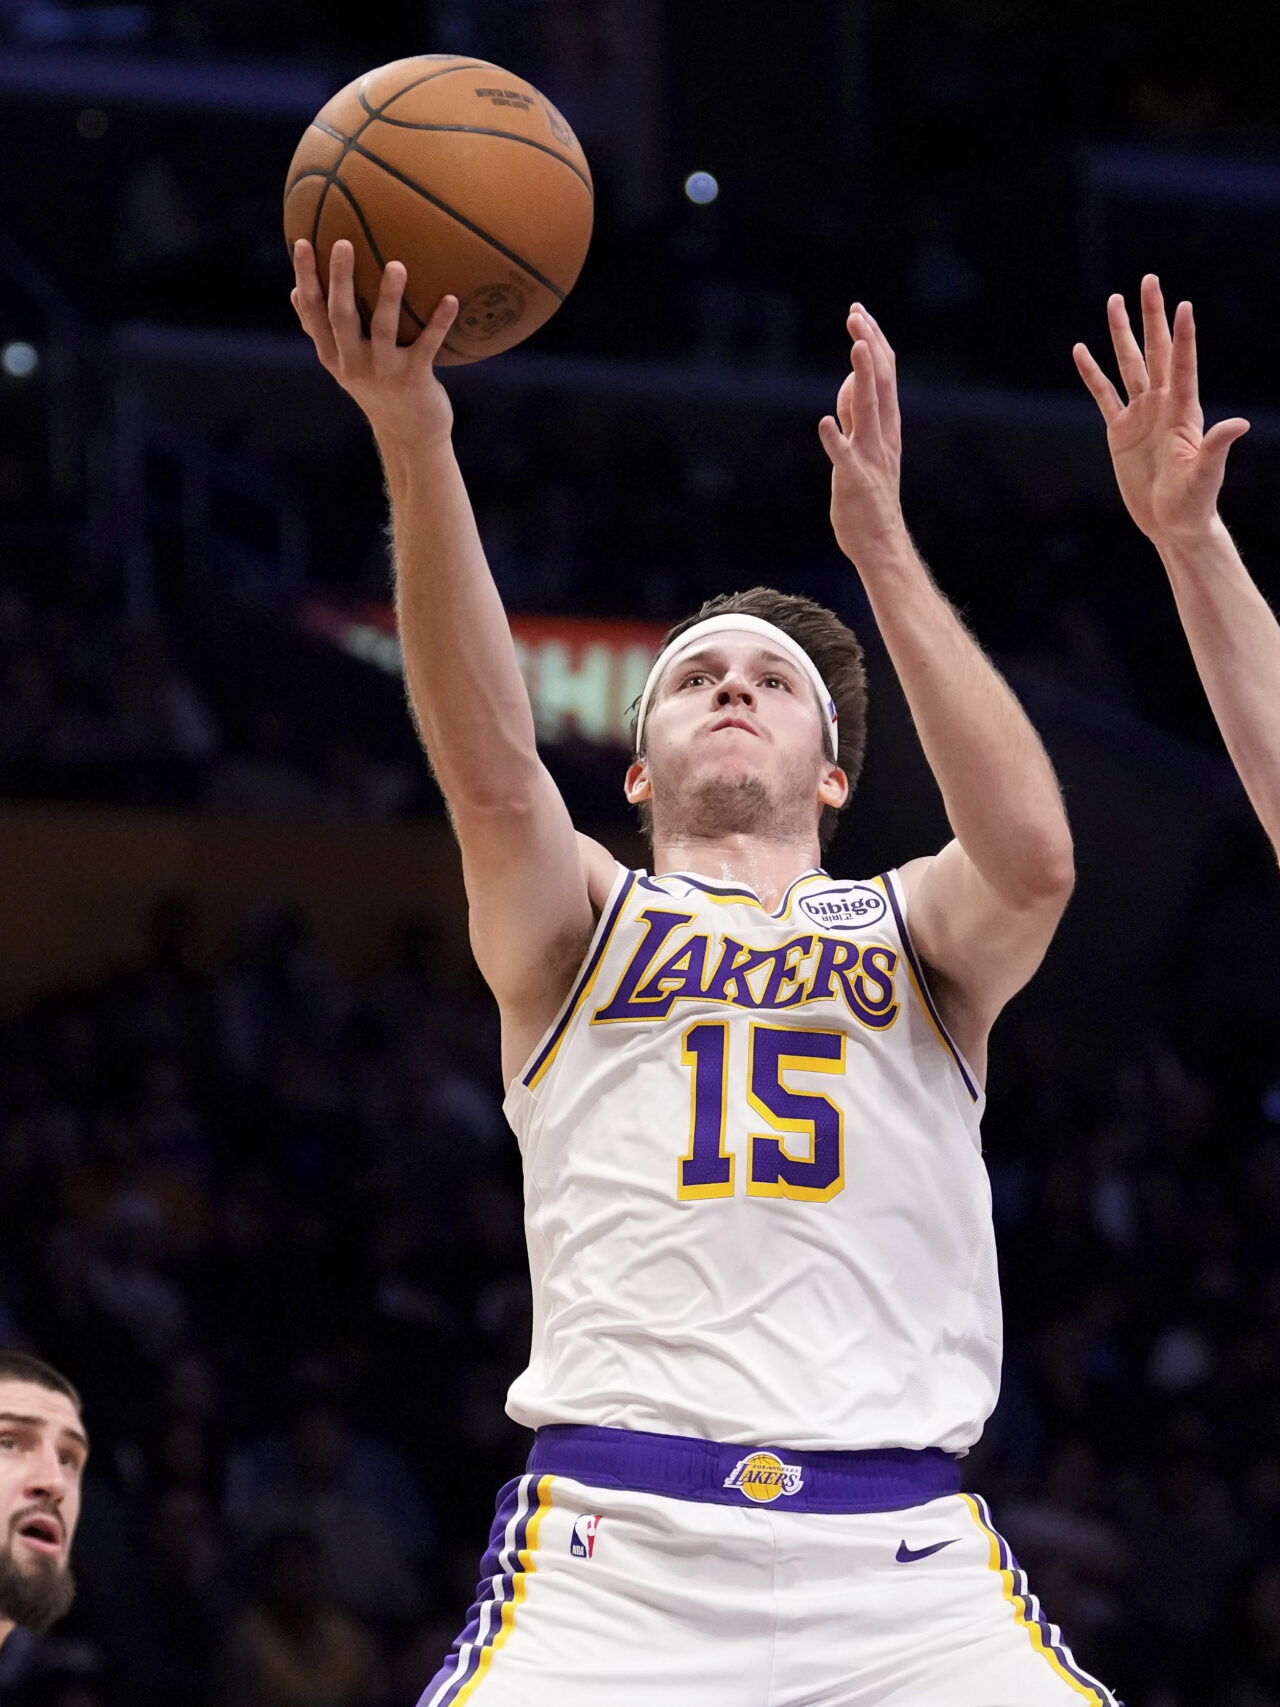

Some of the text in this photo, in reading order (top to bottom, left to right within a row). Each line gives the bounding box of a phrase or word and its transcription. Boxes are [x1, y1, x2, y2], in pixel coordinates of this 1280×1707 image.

[805, 898, 880, 915] bibigo
[822, 912, 854, 922] 비비고
[591, 907, 901, 1031] LAKERS
[677, 1020, 847, 1203] 15
[728, 1463, 799, 1492] LAKERS
[767, 1465, 799, 1473] ANGELES
[572, 1544, 584, 1556] NBA
